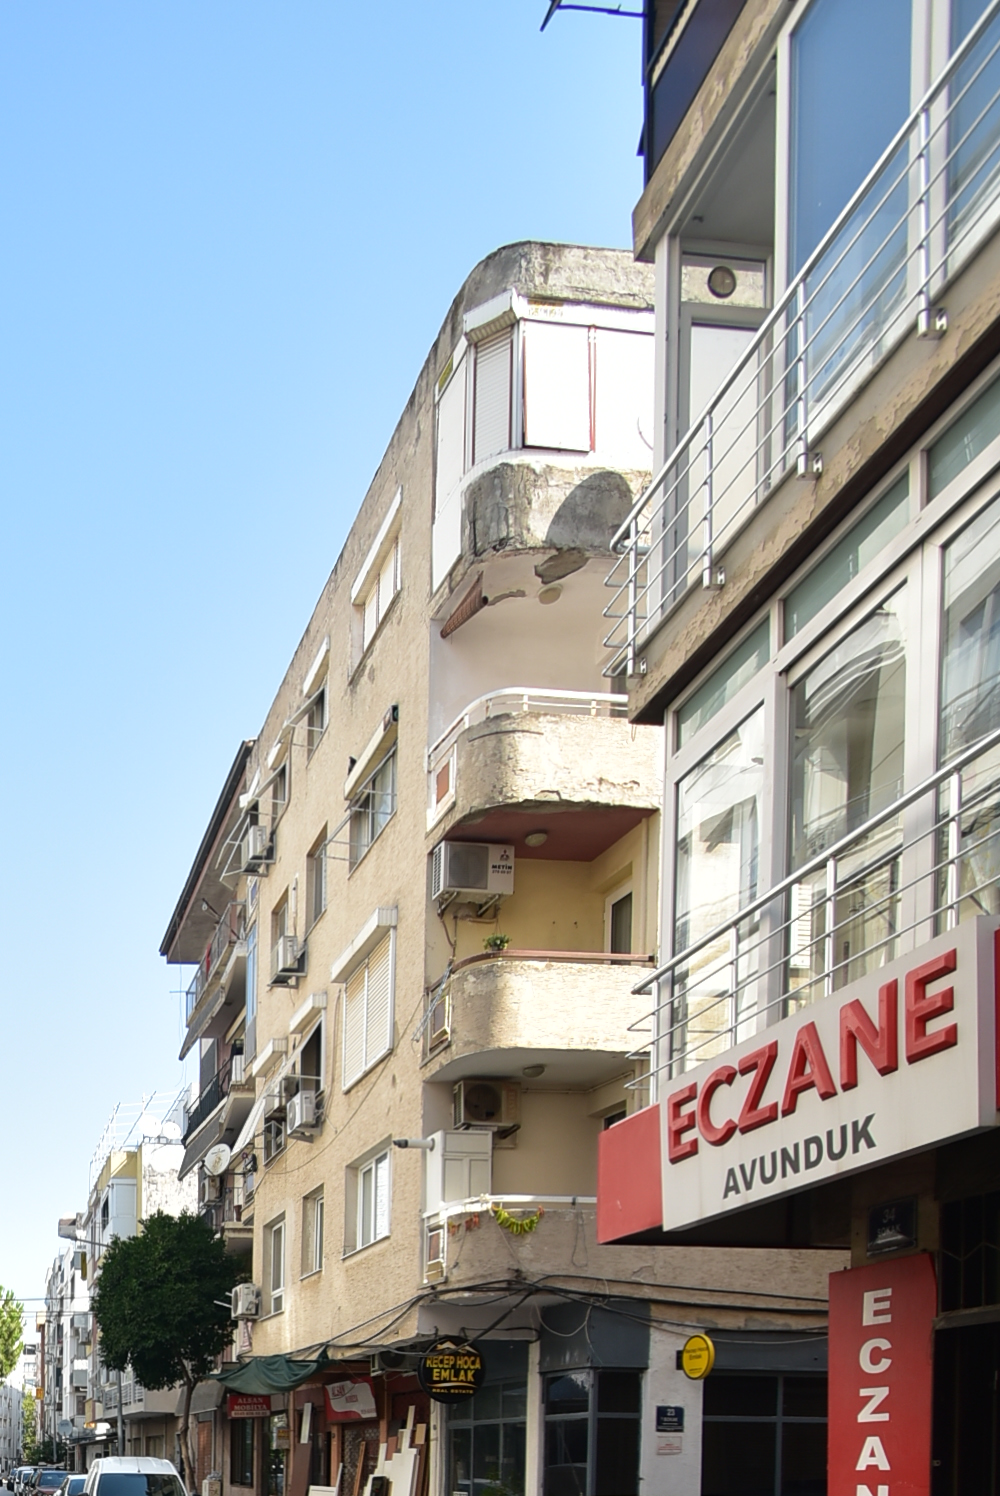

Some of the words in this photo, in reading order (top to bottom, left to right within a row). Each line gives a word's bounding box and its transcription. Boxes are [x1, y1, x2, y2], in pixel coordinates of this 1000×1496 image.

[667, 948, 957, 1165] ECZANE
[723, 1113, 877, 1199] AVUNDUK
[882, 1208, 896, 1223] 34
[426, 1356, 455, 1368] RECEP
[456, 1356, 481, 1369] HOCA
[433, 1369, 475, 1382] EMLAK
[667, 1408, 676, 1416] 23
